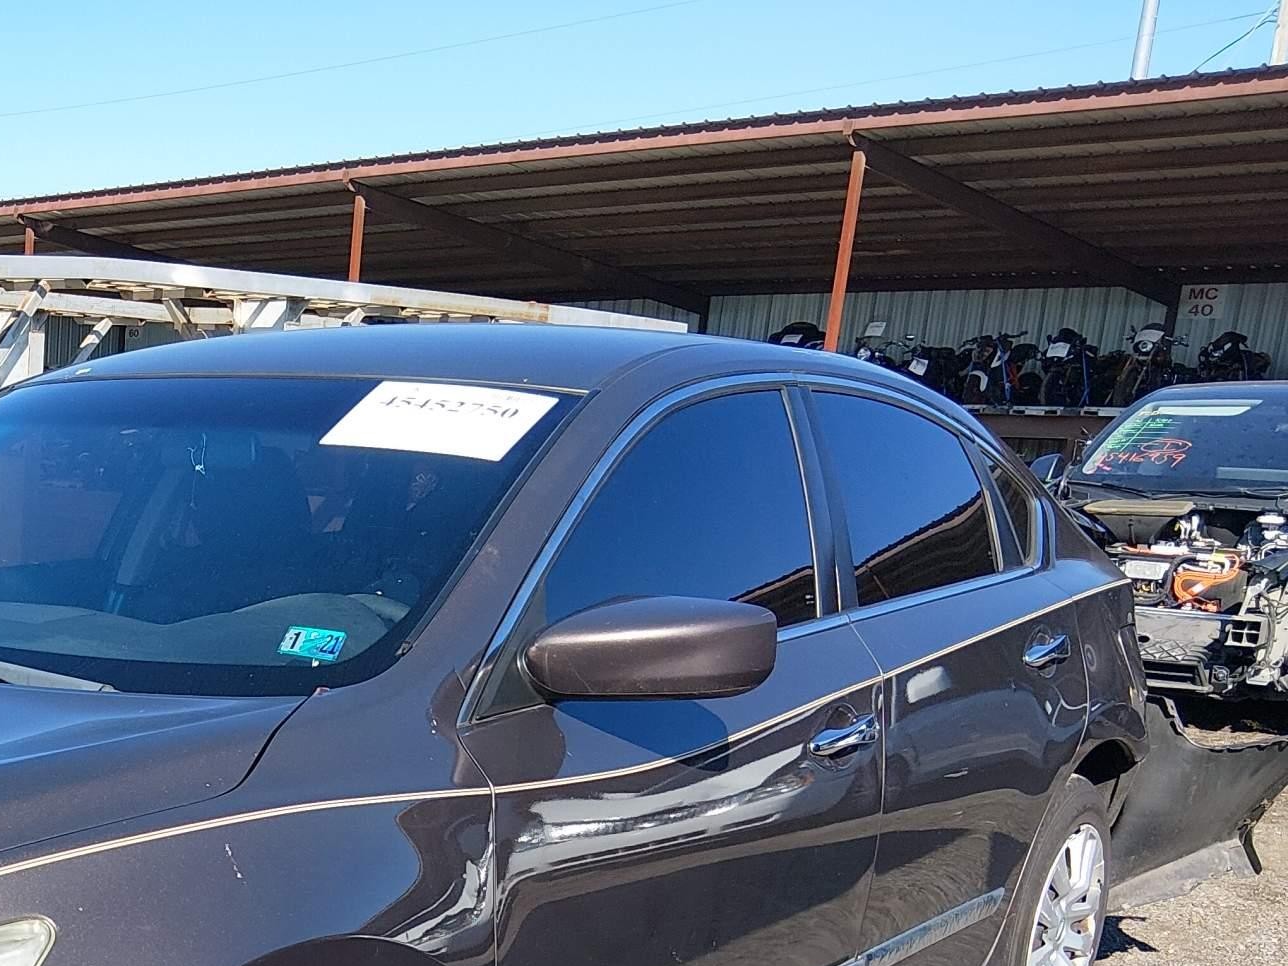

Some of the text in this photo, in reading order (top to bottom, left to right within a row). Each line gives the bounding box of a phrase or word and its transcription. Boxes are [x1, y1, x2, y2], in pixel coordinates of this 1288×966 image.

[1188, 287, 1219, 300] MC
[1188, 304, 1214, 317] 40
[379, 395, 520, 419] 45452750
[319, 634, 342, 655] 21
